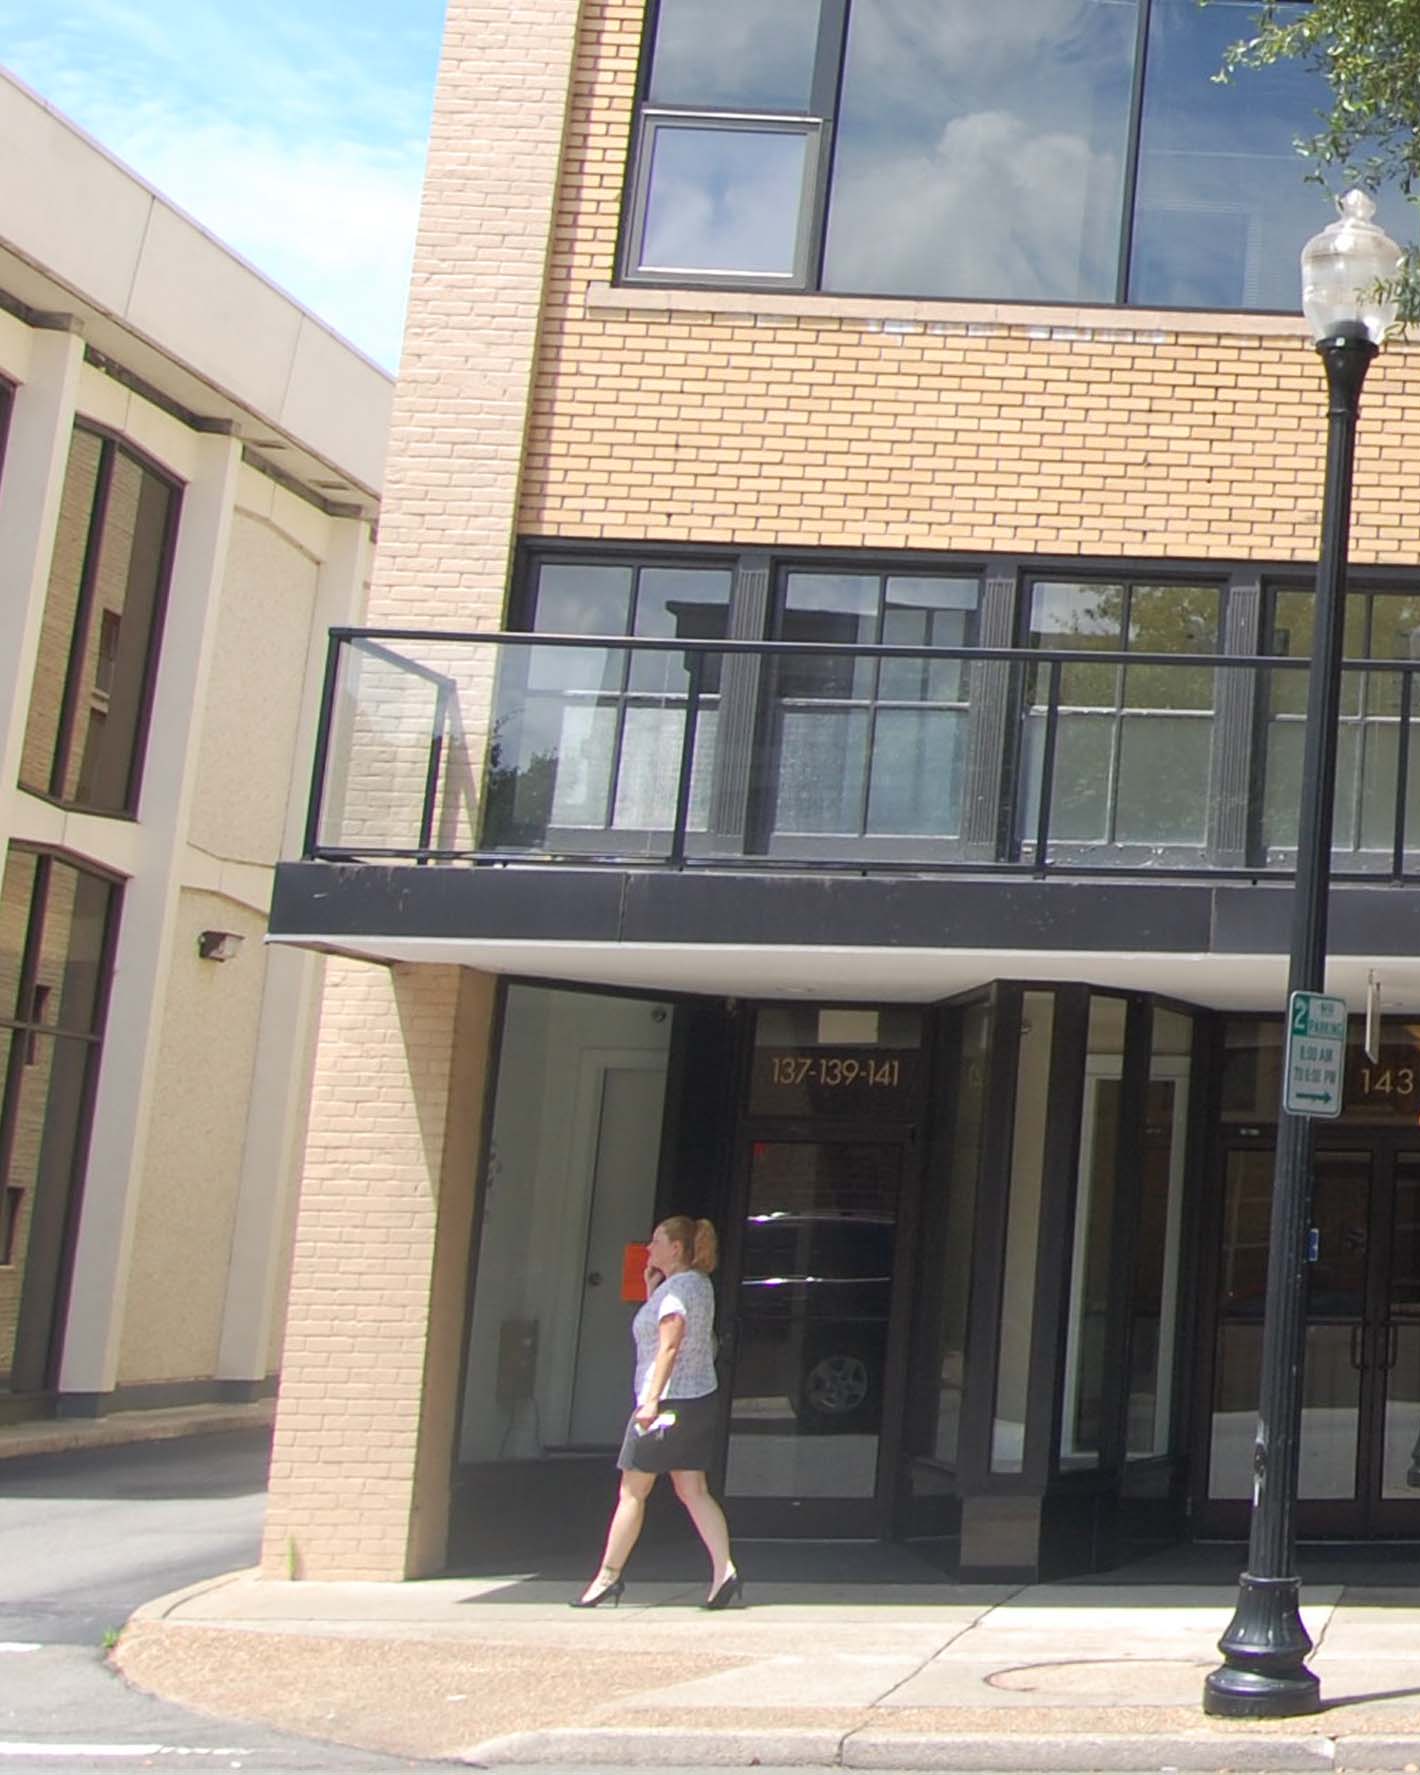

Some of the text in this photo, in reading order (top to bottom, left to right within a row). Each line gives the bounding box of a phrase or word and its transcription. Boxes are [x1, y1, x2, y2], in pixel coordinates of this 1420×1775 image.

[1294, 997, 1307, 1029] 2
[771, 1057, 899, 1086] 137-139-141
[1360, 1068, 1414, 1094] 143
